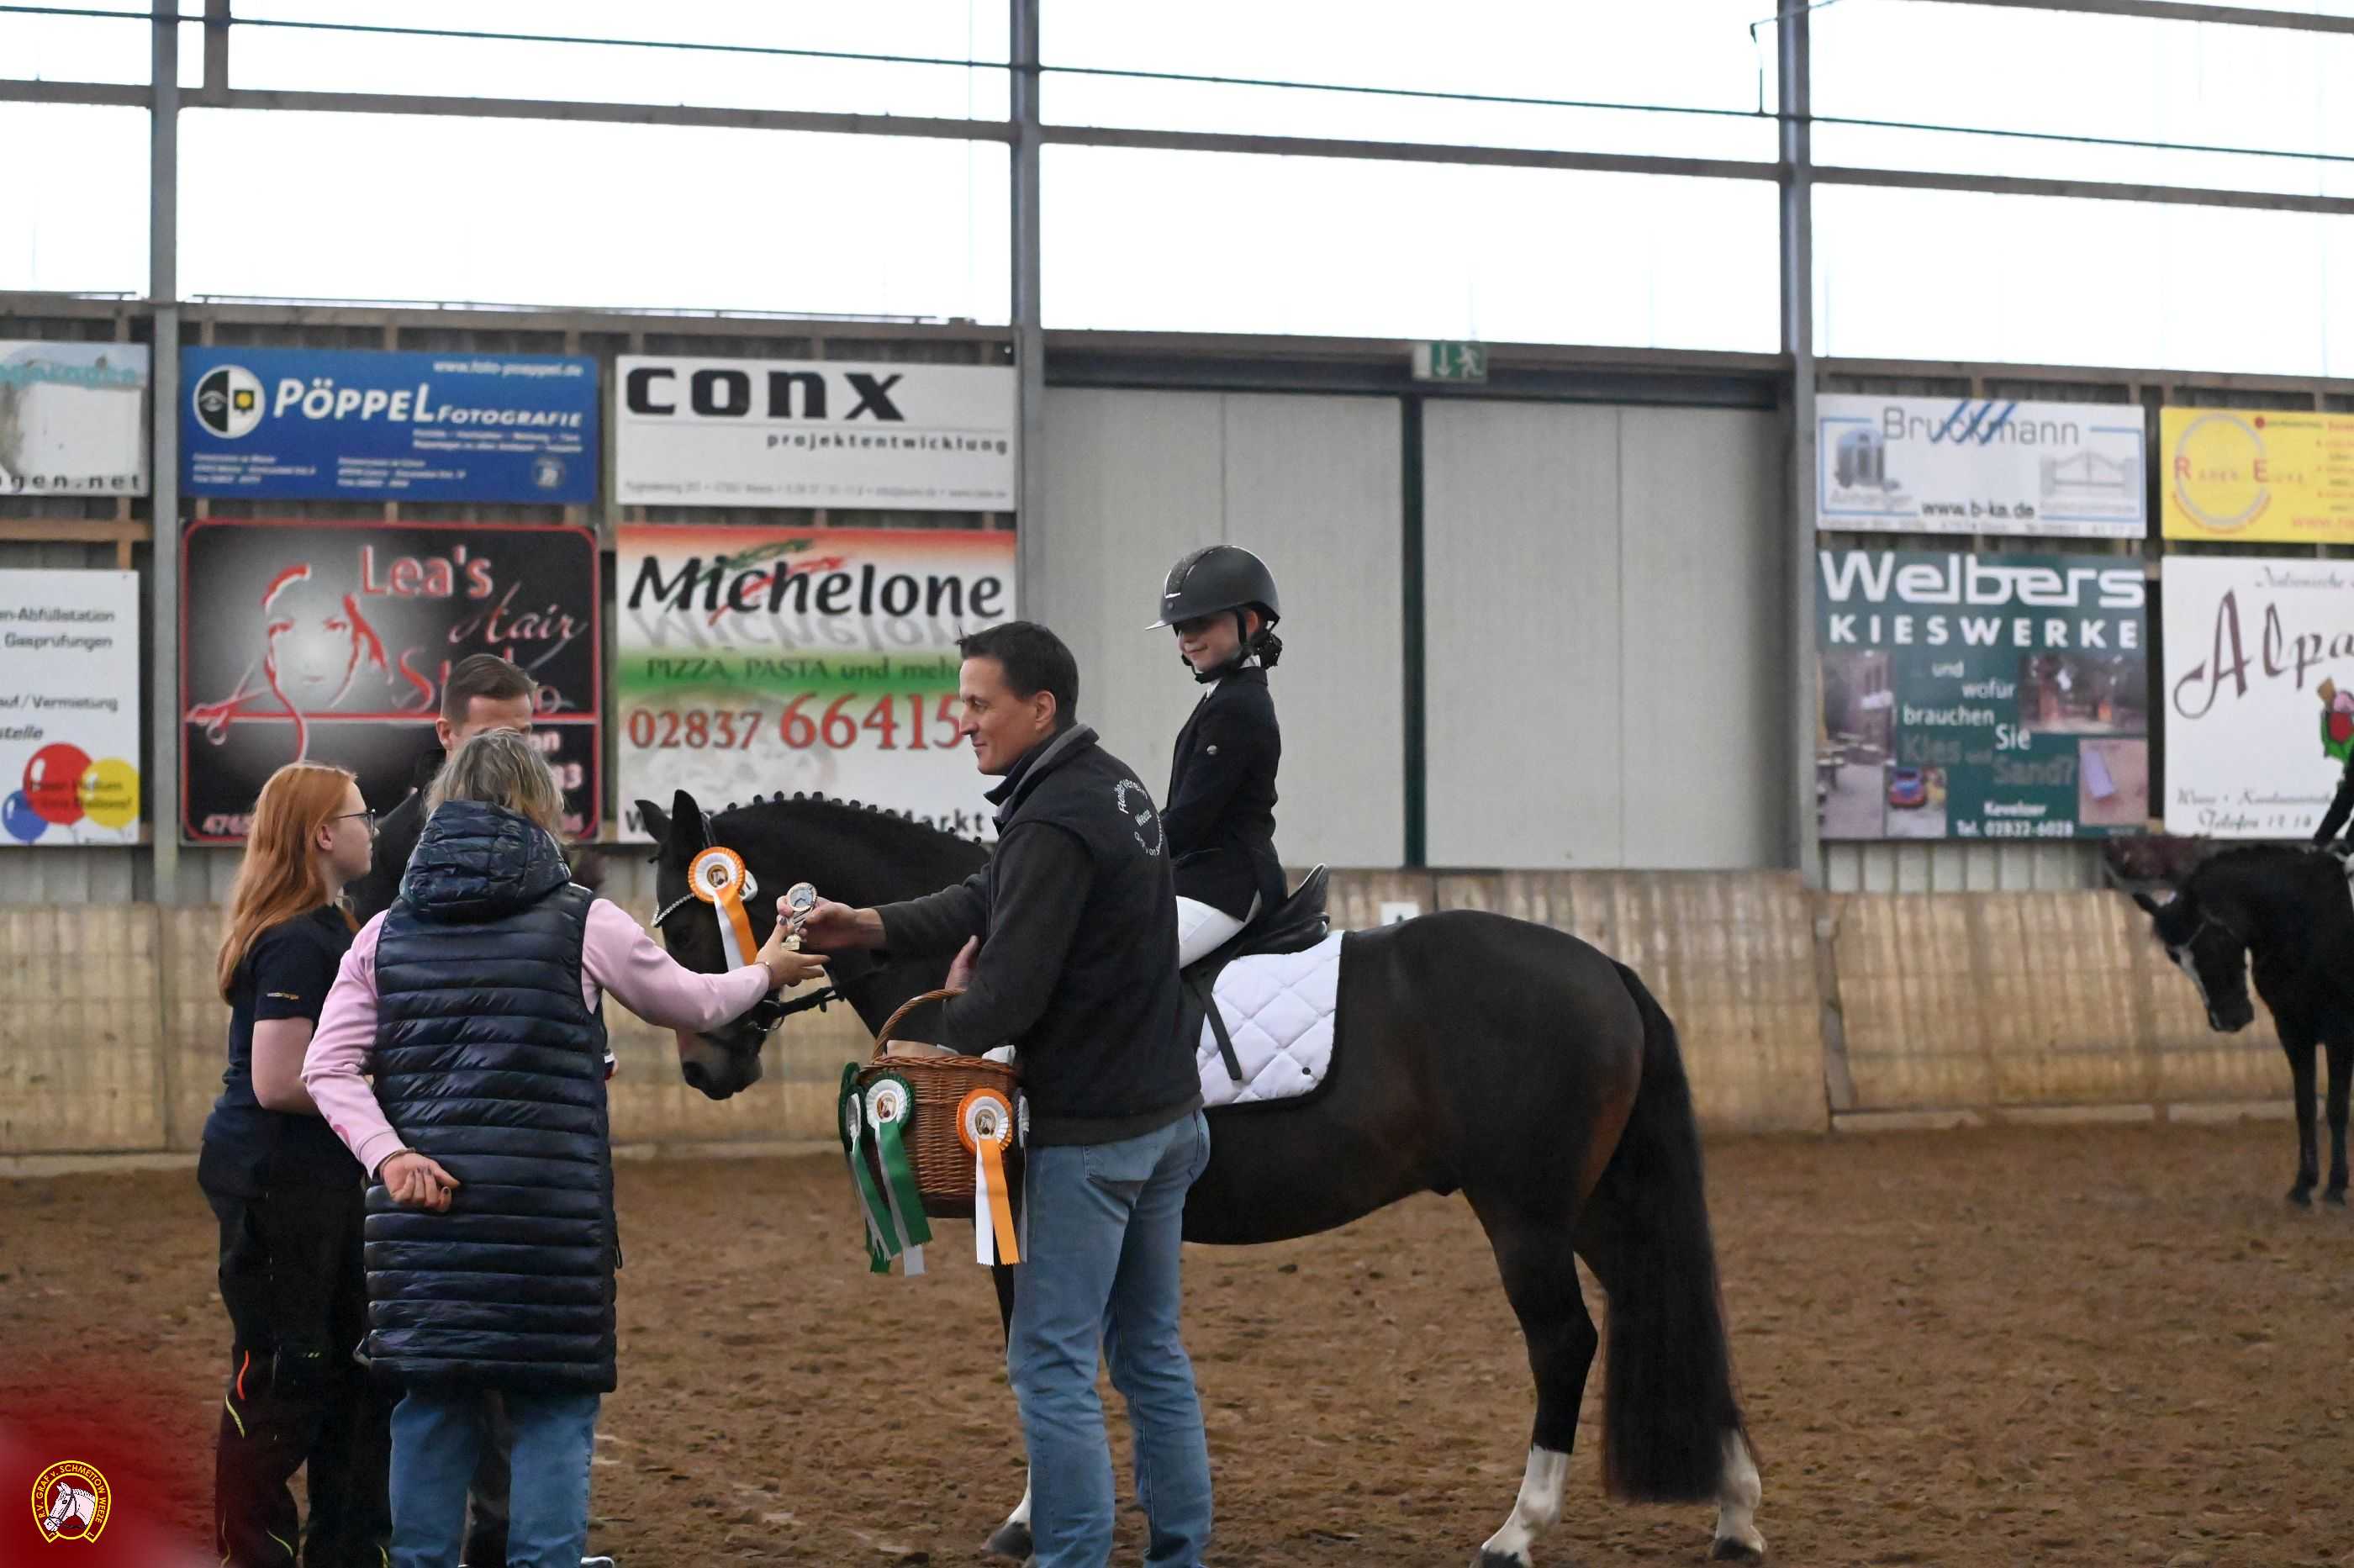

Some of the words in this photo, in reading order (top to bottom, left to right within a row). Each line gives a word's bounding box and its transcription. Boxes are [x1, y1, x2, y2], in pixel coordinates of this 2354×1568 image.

[625, 367, 905, 422] conx
[767, 433, 1007, 455] projektentwicklung
[361, 545, 494, 599] Lea's
[627, 555, 1004, 618] Michelone
[1819, 551, 2145, 608] Welbers
[1829, 614, 2139, 649] KIESWERKE
[745, 658, 828, 679] PASTA
[842, 658, 889, 679] und
[1932, 661, 1964, 678] und
[628, 707, 763, 750] 02837
[1903, 704, 1995, 726] brauchen
[1995, 723, 2030, 750] Sie
